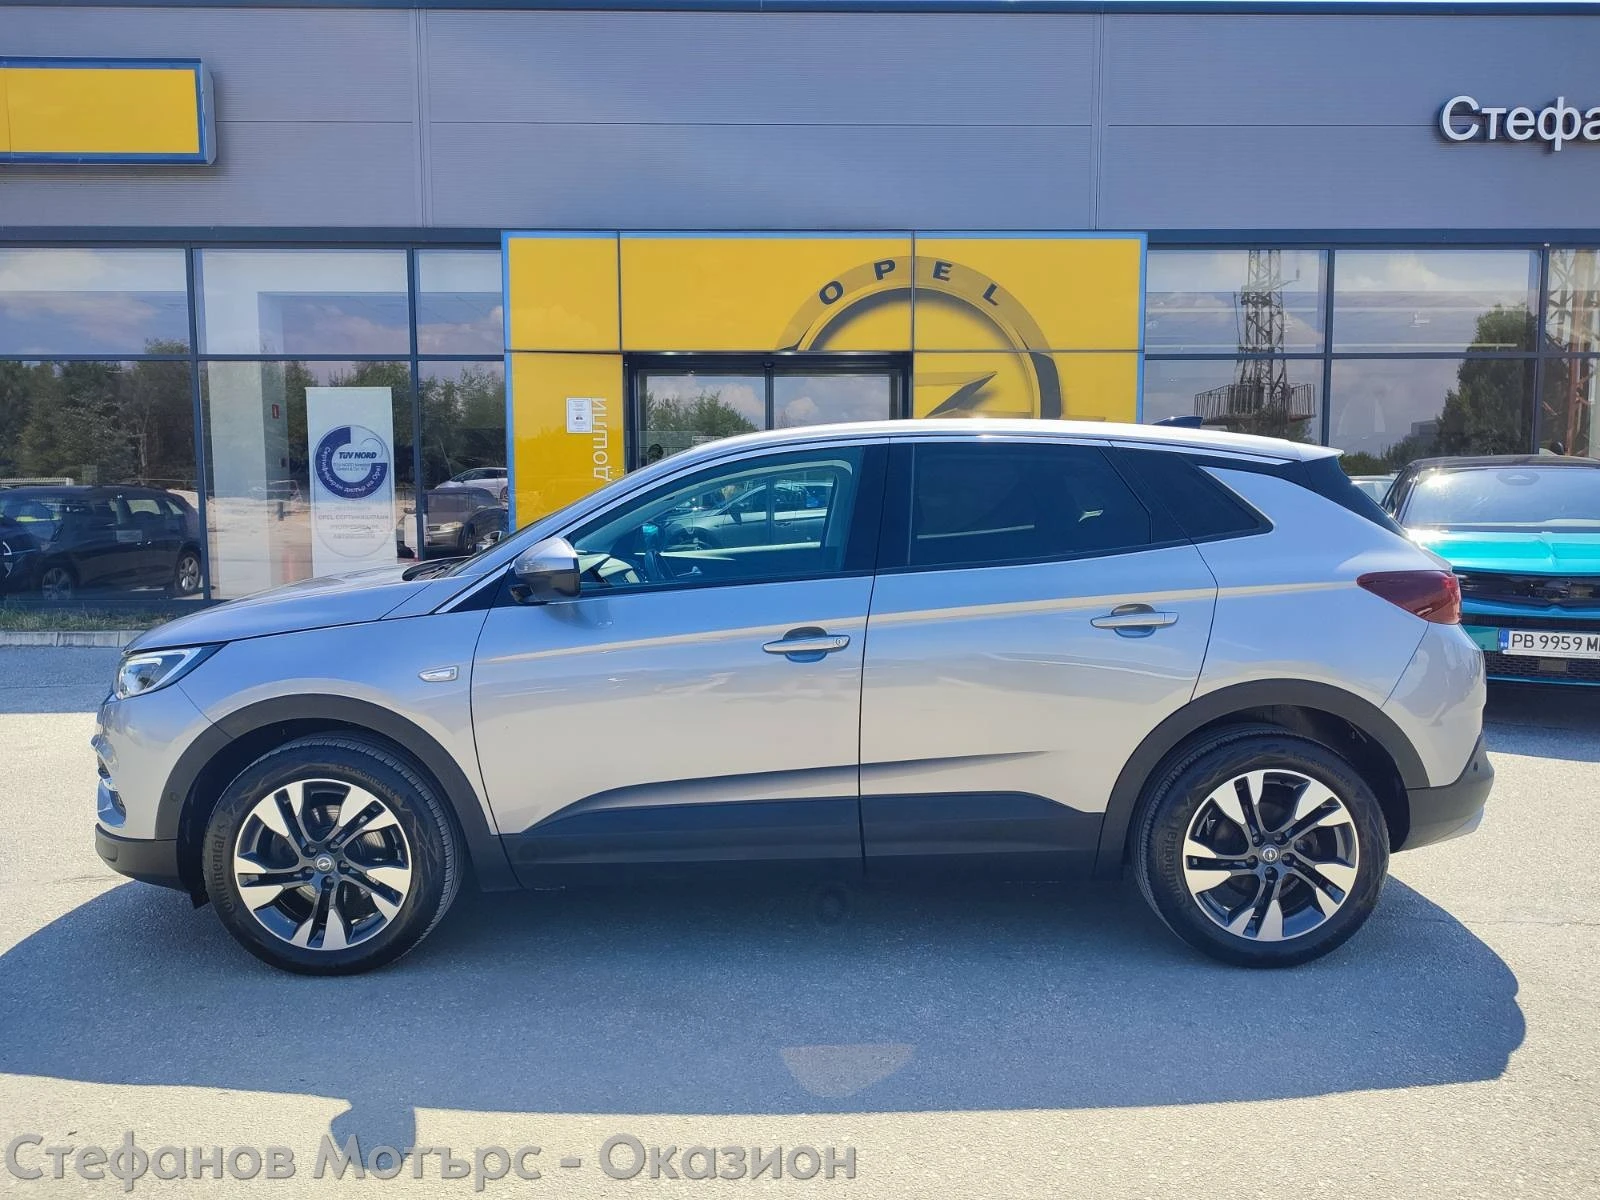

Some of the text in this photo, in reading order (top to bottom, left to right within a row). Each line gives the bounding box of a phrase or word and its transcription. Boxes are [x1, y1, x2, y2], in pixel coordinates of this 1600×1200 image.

[1442, 95, 1600, 151] Стефа
[818, 259, 1001, 307] OPEL
[354, 451, 377, 459] NORD
[1511, 633, 1535, 649] PB
[1539, 634, 1583, 651] 9959
[1586, 636, 1600, 652] M
